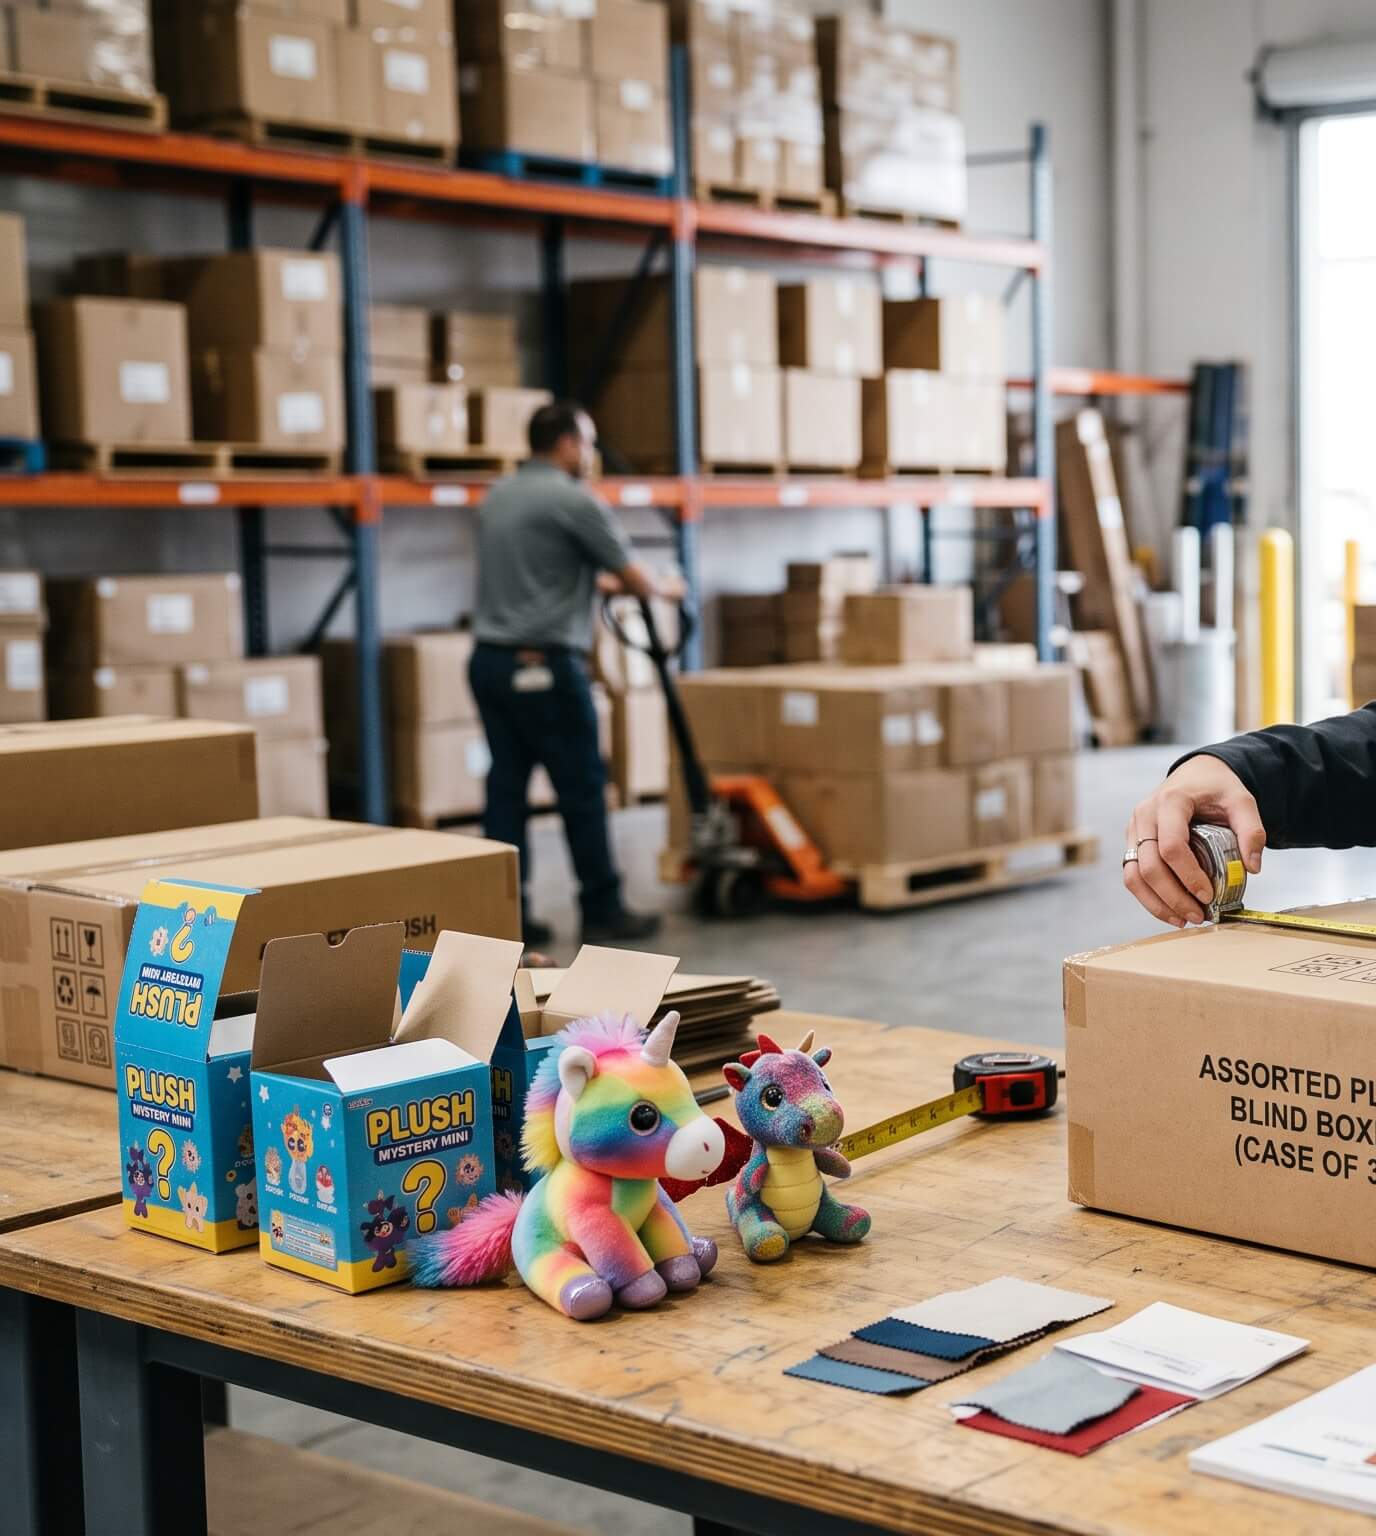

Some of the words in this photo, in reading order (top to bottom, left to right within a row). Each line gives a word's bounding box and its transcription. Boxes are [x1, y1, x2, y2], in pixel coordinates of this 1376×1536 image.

[129, 979, 203, 1029] PLUSH
[125, 1063, 197, 1115] PLUSH
[1199, 1054, 1341, 1101] ASSORTED
[132, 1103, 170, 1123] MYSTERY
[171, 1114, 192, 1129] MINI
[366, 1088, 476, 1149] PLUSH
[1230, 1095, 1308, 1132] BLIND
[378, 1137, 439, 1163] MYSTERY
[441, 1130, 469, 1147] MINI
[1234, 1133, 1314, 1174] (CASE
[1322, 1150, 1359, 1180] OF
